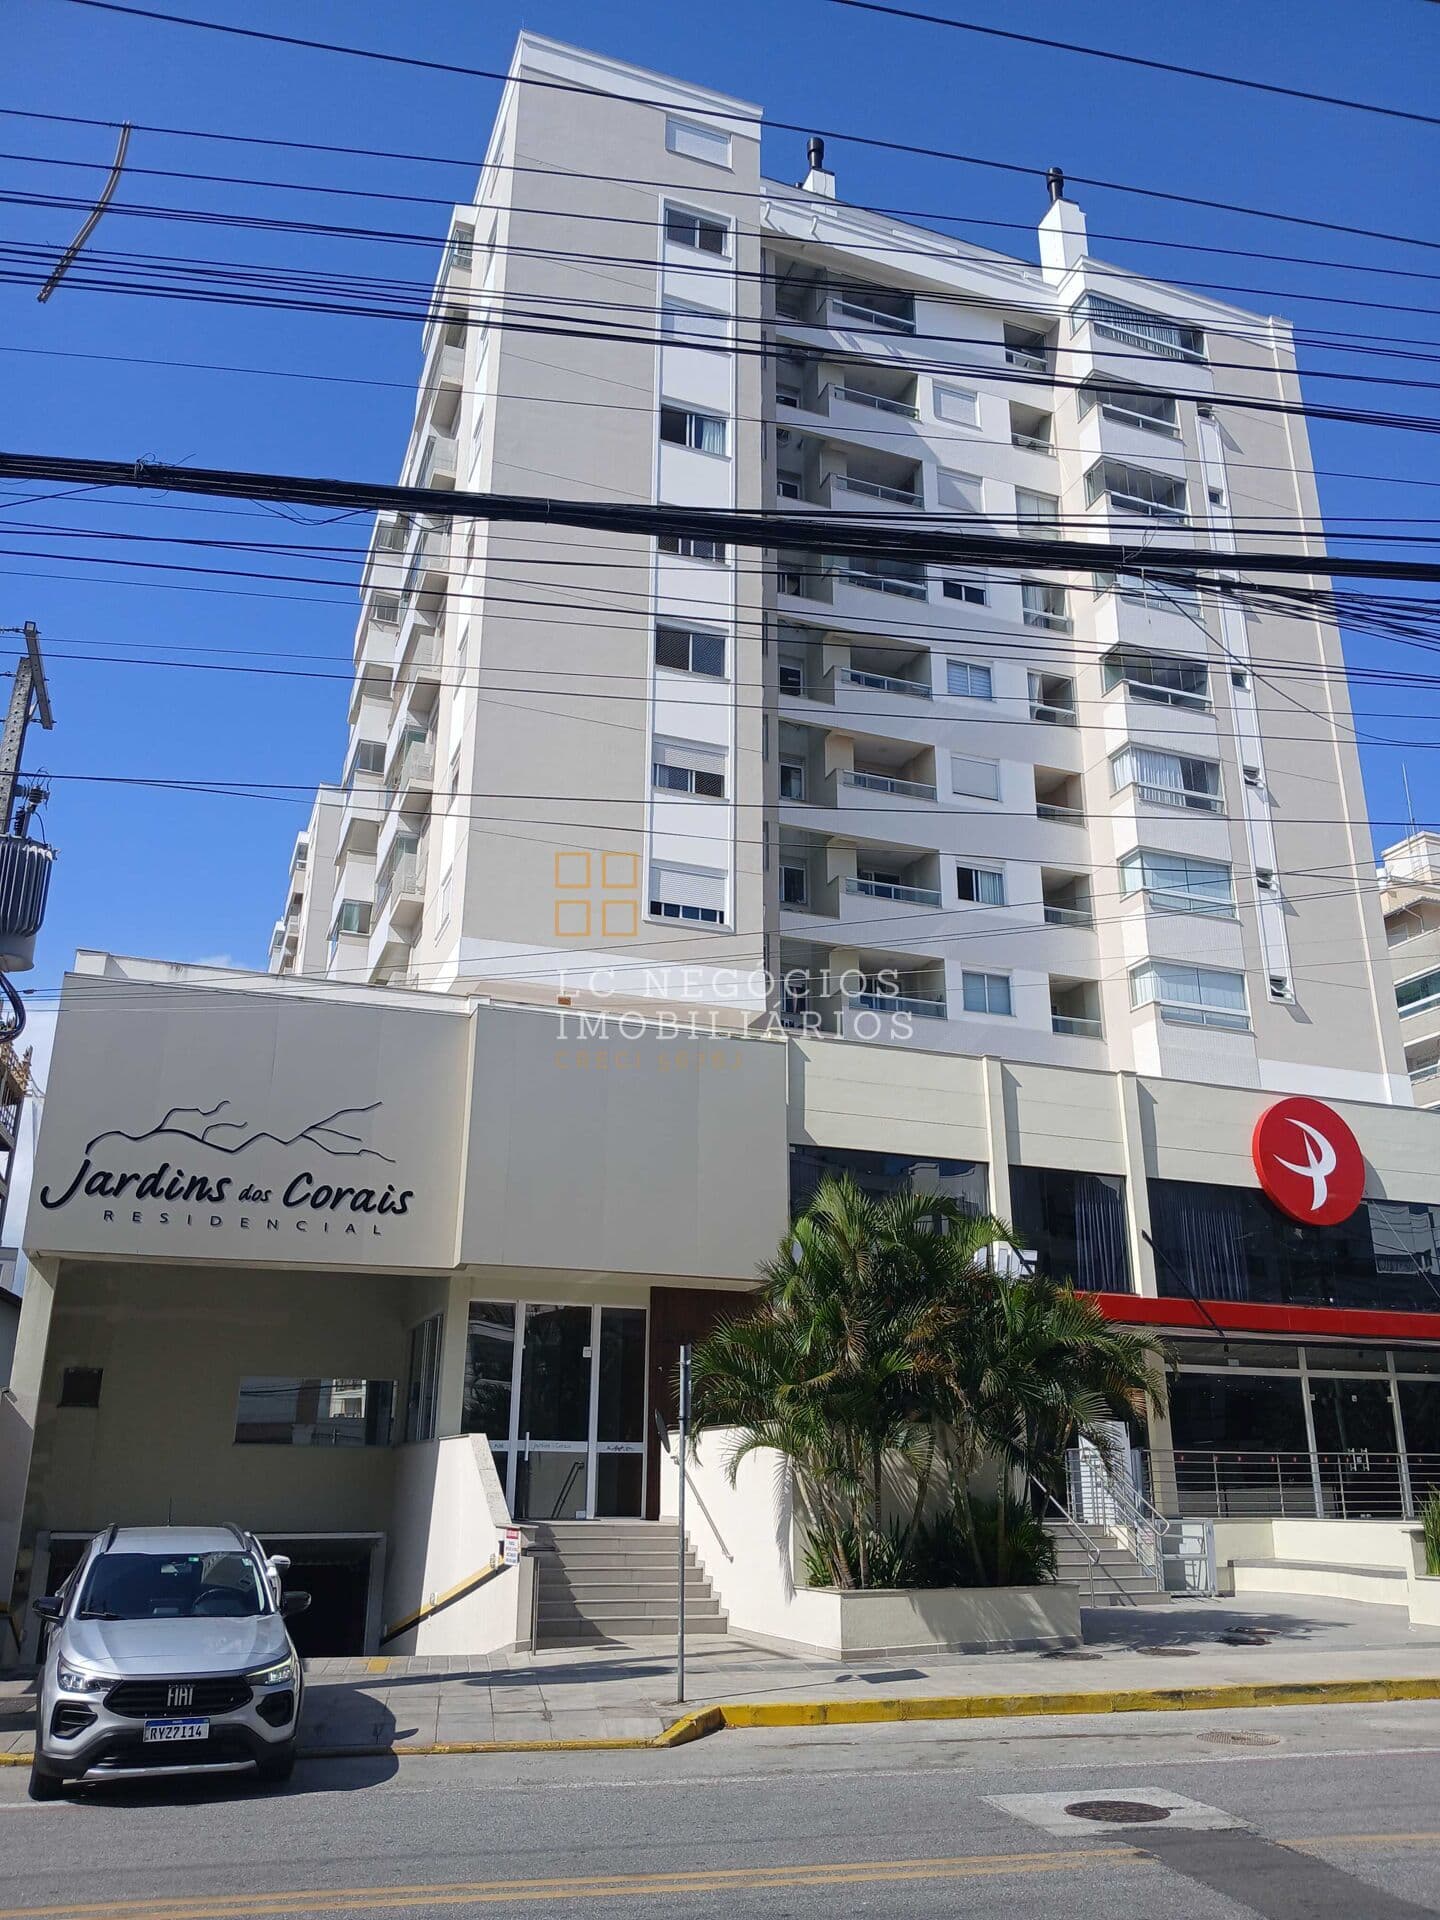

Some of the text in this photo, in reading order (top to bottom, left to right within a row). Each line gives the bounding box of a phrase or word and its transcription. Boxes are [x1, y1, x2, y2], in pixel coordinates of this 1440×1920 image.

[238, 1184, 272, 1202] dos
[282, 1172, 413, 1214] Corais
[103, 1210, 381, 1236] RESIDENCIAL
[167, 1684, 196, 1706] FIAT
